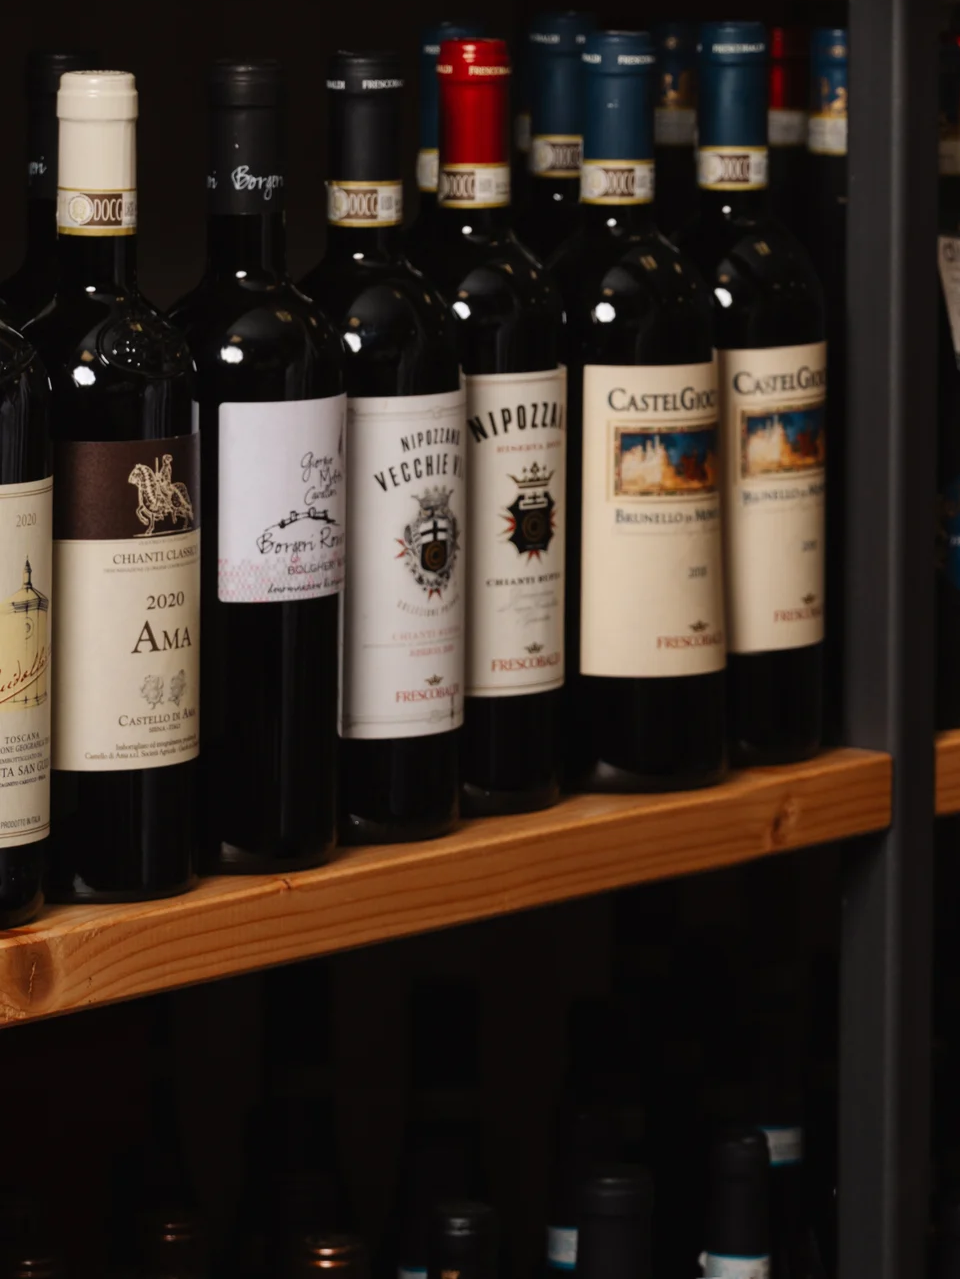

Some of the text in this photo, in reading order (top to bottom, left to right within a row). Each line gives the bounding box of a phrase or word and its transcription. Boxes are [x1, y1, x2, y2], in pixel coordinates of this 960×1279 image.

[373, 453, 449, 492] VECCHIE
[113, 550, 165, 565] CHIANTI
[146, 590, 185, 610] 2020
[131, 620, 192, 654] AMA
[18, 763, 36, 776] SAN
